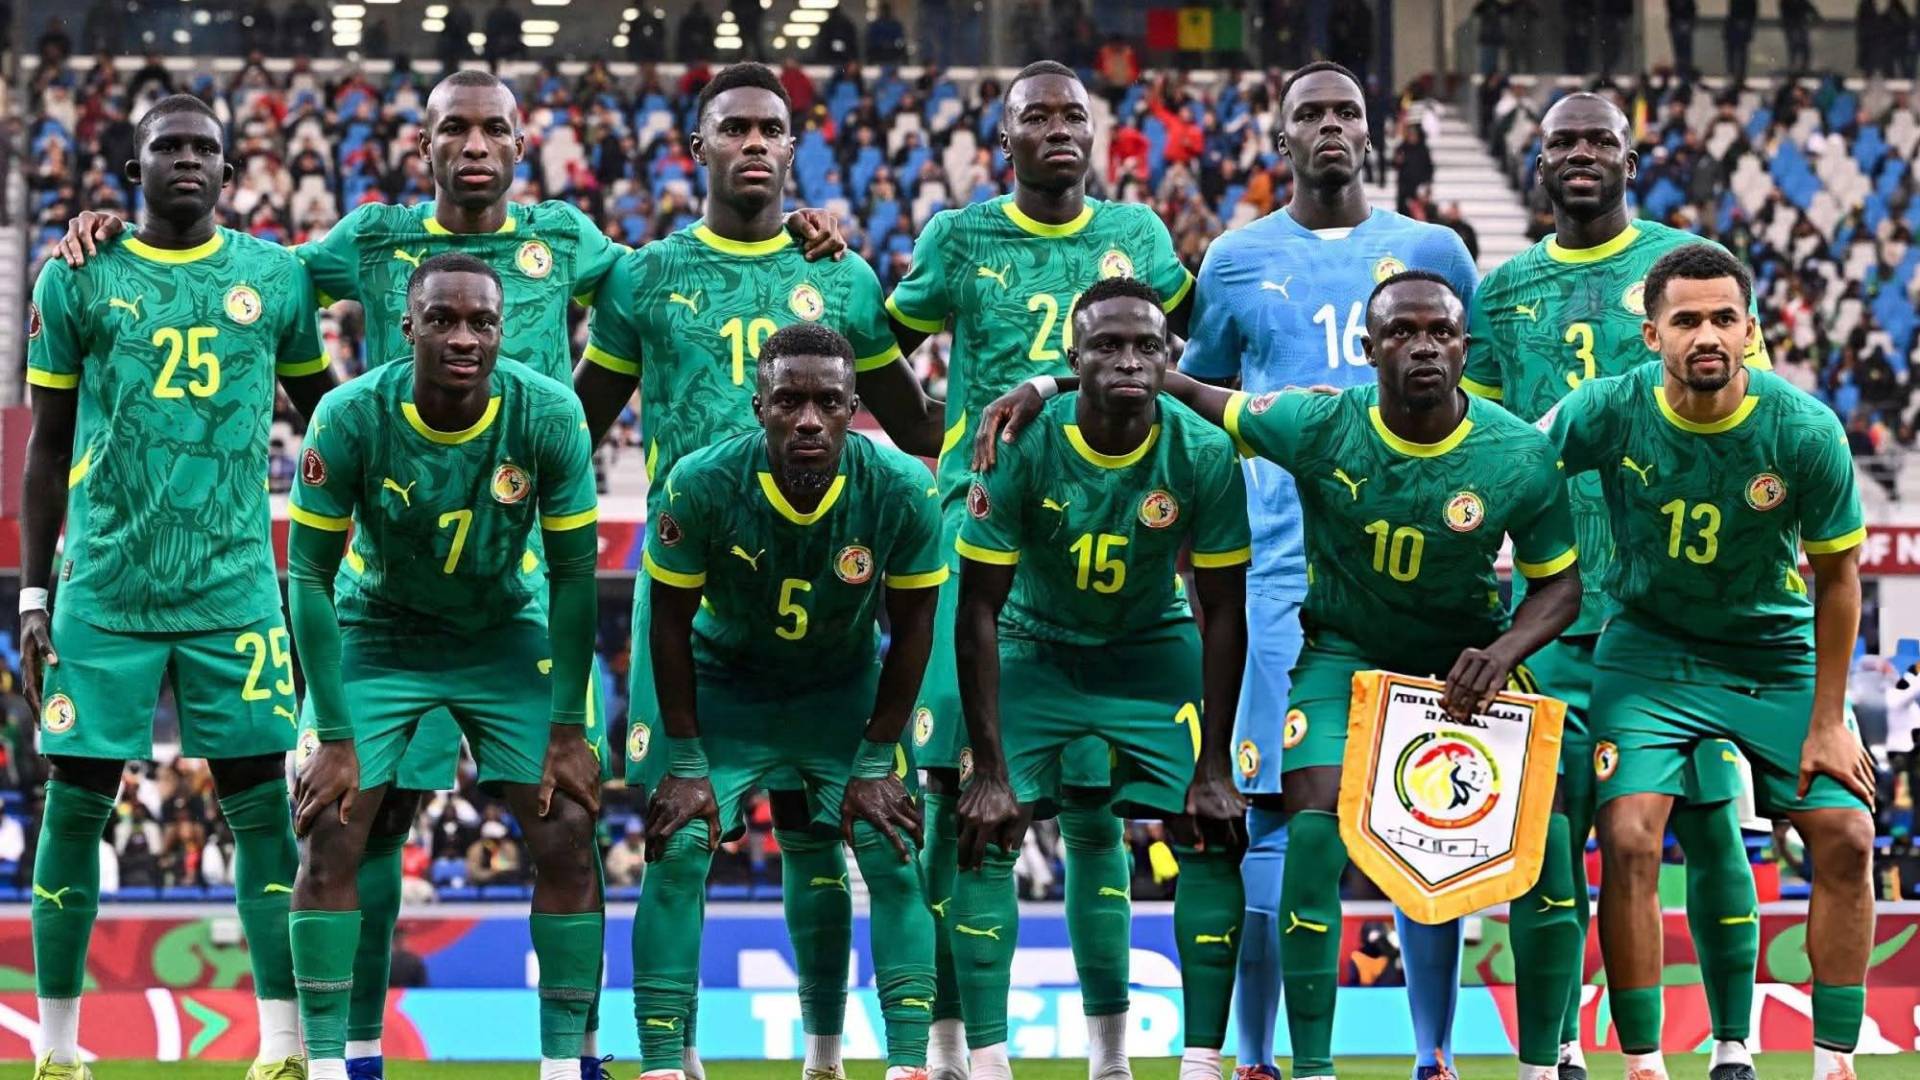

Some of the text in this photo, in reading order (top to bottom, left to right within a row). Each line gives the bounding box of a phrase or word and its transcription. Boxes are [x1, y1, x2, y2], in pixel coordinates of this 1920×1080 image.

[1027, 292, 1082, 360] 2
[1313, 301, 1370, 368] 16
[1565, 322, 1595, 391] 3
[152, 327, 220, 398] 25
[439, 509, 473, 574] 7
[1069, 533, 1129, 593] 15
[1364, 519, 1424, 581] 10
[1661, 498, 1721, 564] 13
[775, 578, 812, 639] 5
[235, 626, 295, 701] 25
[1175, 699, 1204, 763] 1
